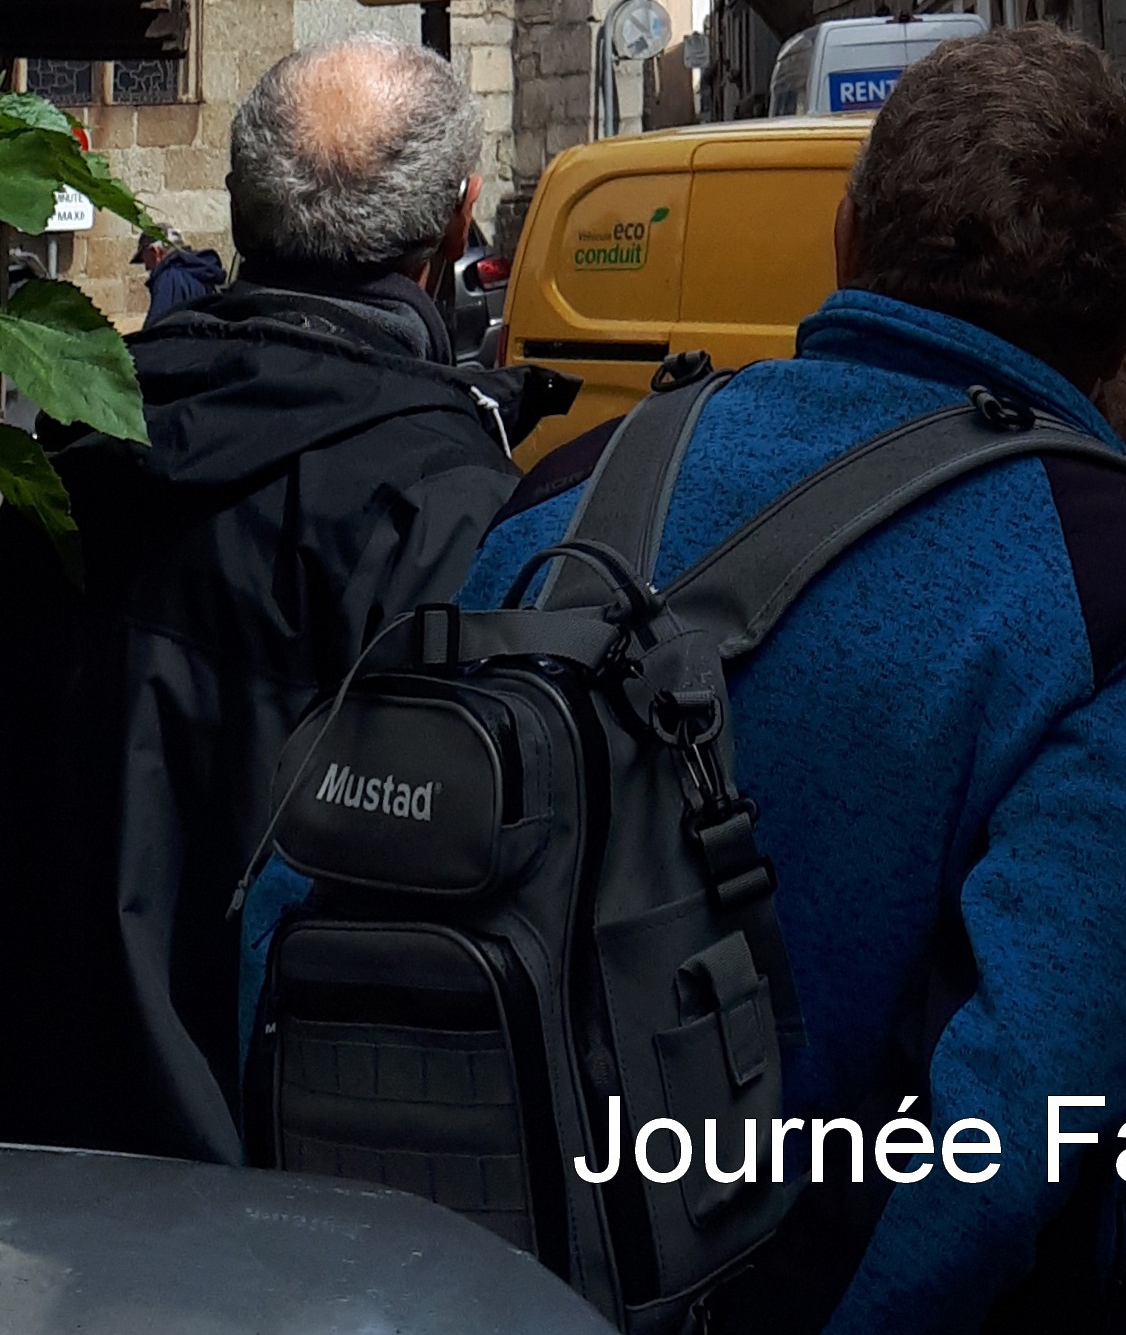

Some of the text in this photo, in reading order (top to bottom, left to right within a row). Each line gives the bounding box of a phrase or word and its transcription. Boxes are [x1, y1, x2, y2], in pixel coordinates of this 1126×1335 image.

[840, 79, 898, 103] RENT
[575, 242, 641, 264] conduit
[315, 762, 433, 821] Mustad
